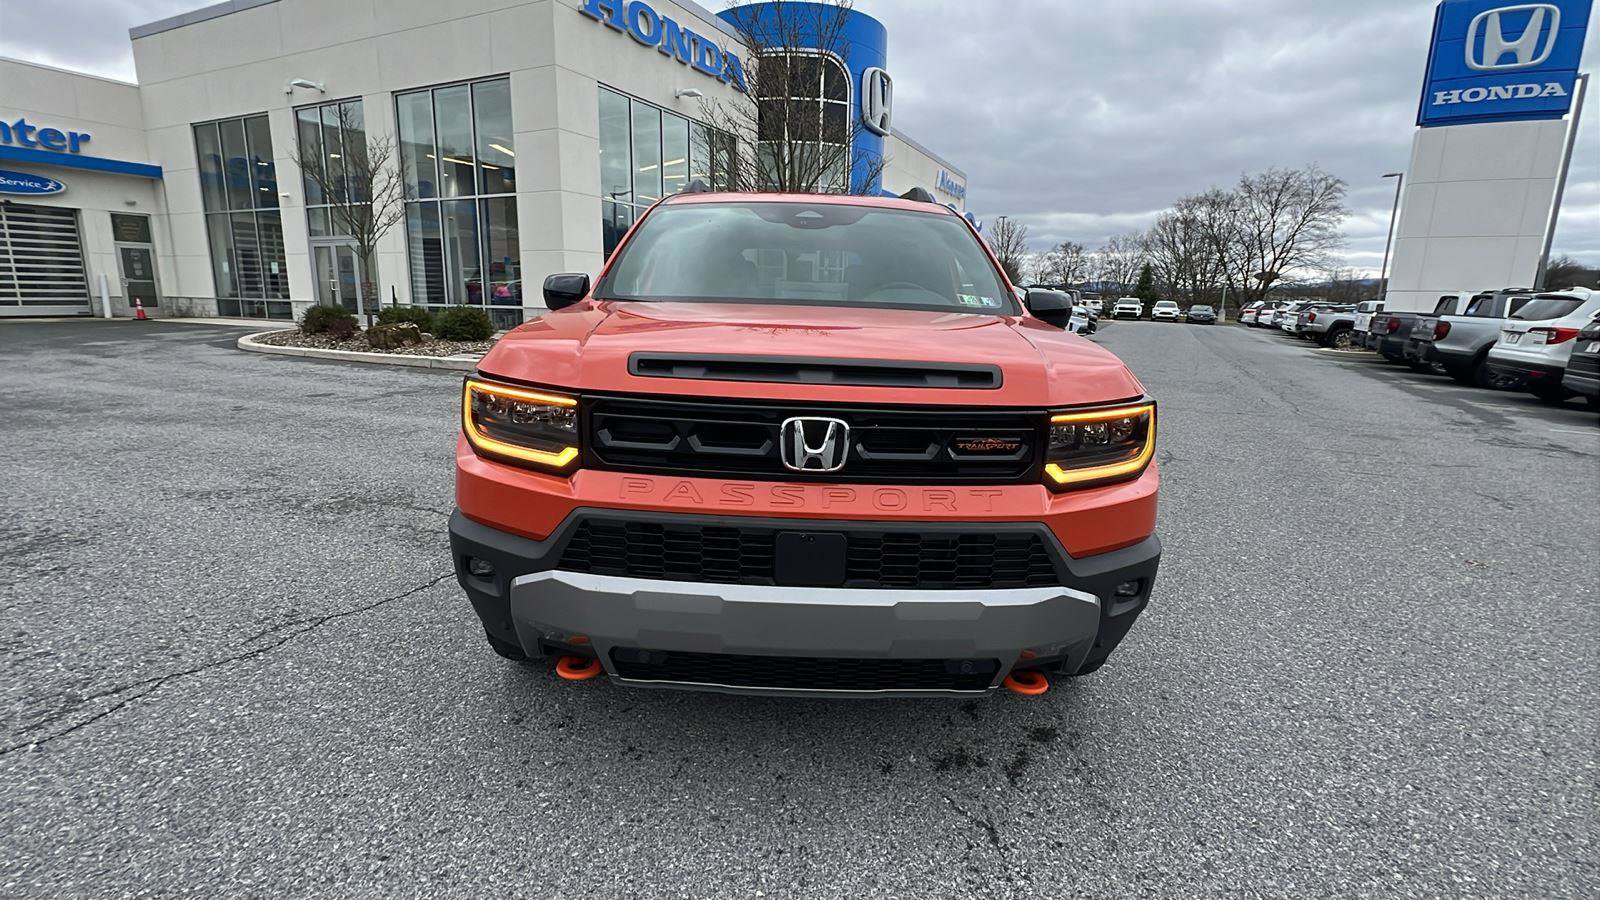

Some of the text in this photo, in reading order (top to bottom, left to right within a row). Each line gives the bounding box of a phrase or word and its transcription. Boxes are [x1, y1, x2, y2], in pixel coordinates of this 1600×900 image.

[579, 0, 748, 93] HONDA
[1432, 82, 1568, 106] HONDA
[957, 442, 1020, 450] TRAILSPORT
[619, 476, 1004, 513] PASSPORT
